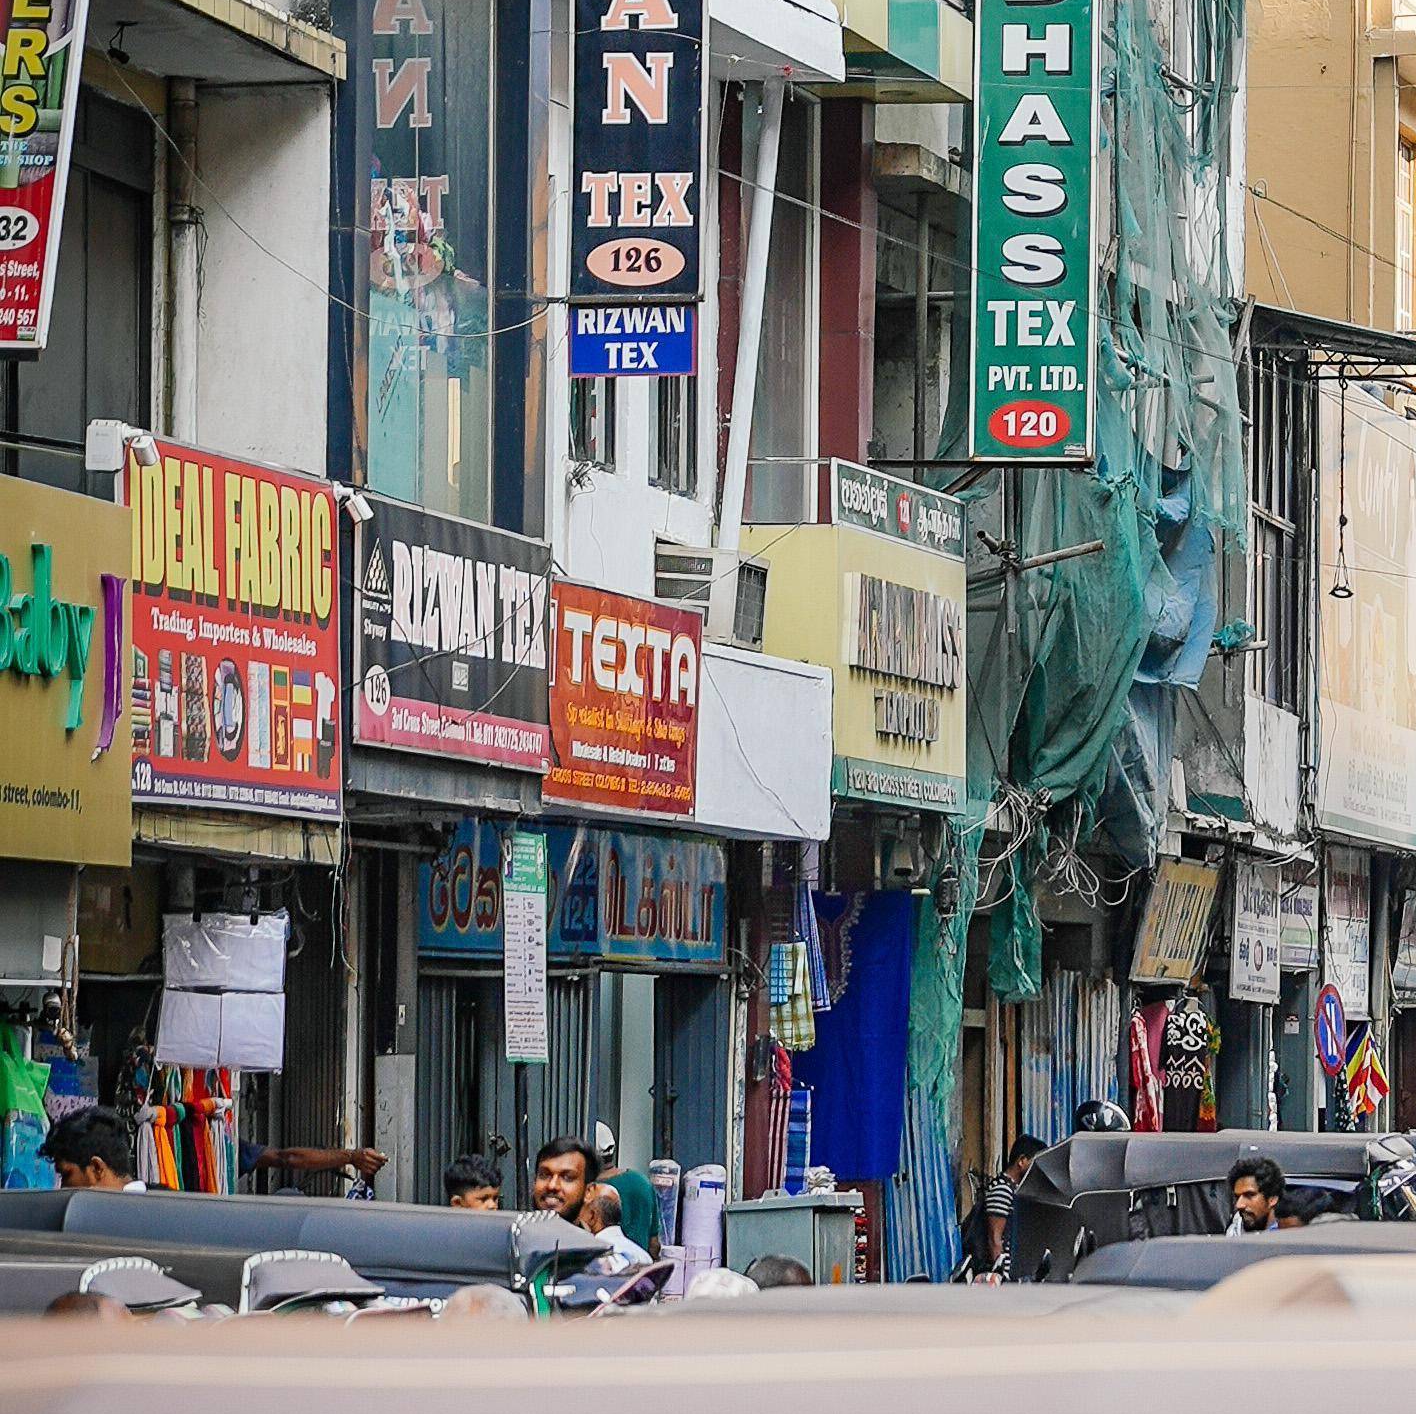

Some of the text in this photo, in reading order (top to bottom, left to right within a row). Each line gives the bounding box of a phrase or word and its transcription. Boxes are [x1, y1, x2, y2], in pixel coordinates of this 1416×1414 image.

[581, 171, 694, 228] TEX
[7, 260, 40, 281] Street,
[609, 244, 662, 274] 126
[577, 307, 686, 336] RIZWAN
[987, 300, 1076, 347] TEX
[604, 342, 659, 370] TEX
[988, 365, 1084, 391] PVT. LTD.
[1003, 411, 1057, 437] 120
[130, 448, 332, 621] IDEAL FABRIC
[391, 540, 546, 669] RIZWAN TEX
[151, 607, 317, 656] Trading, Importers & Wholesales
[562, 609, 698, 707] TEXTA
[369, 677, 387, 706] 126
